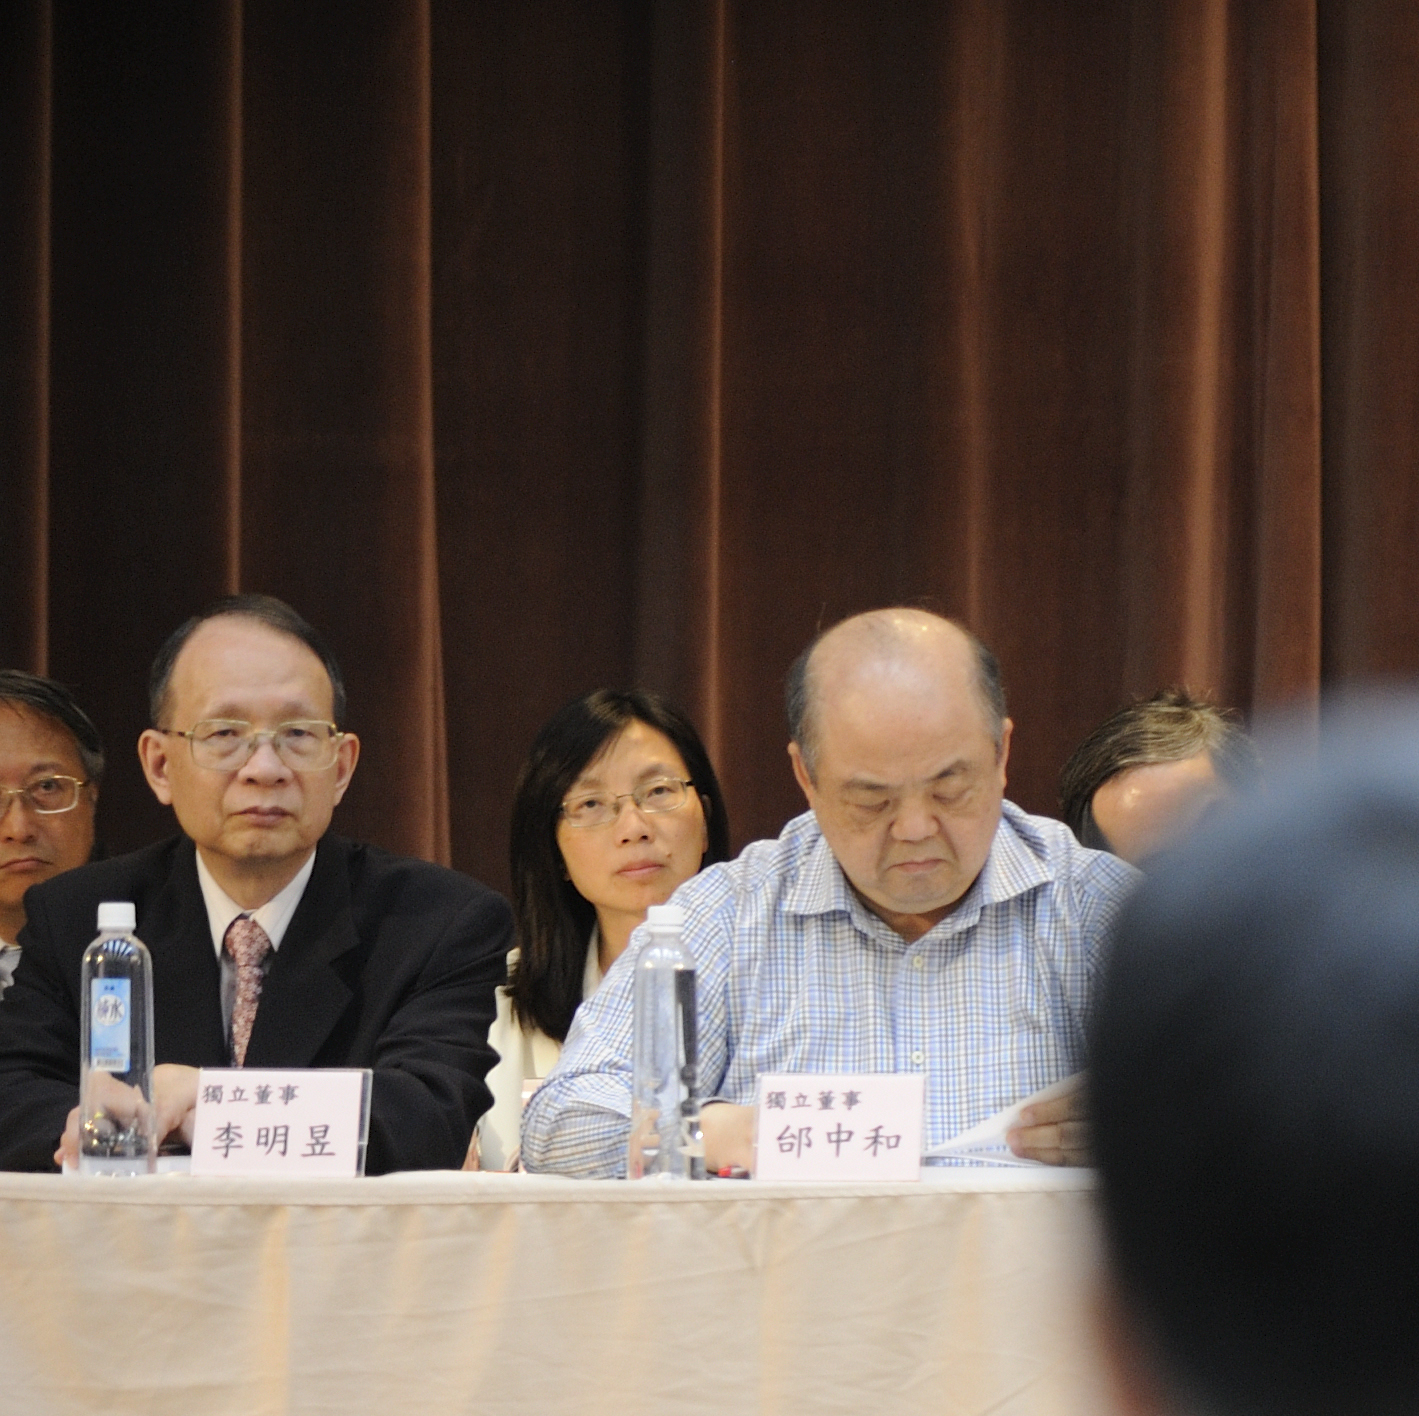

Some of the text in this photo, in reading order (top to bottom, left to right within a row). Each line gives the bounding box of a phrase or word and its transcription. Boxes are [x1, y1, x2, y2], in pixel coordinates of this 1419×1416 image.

[202, 1084, 299, 1105] 獨立董事
[765, 1090, 862, 1110] 獨立董事
[211, 1121, 336, 1159] 李明昱
[776, 1122, 901, 1159] 邰中和
